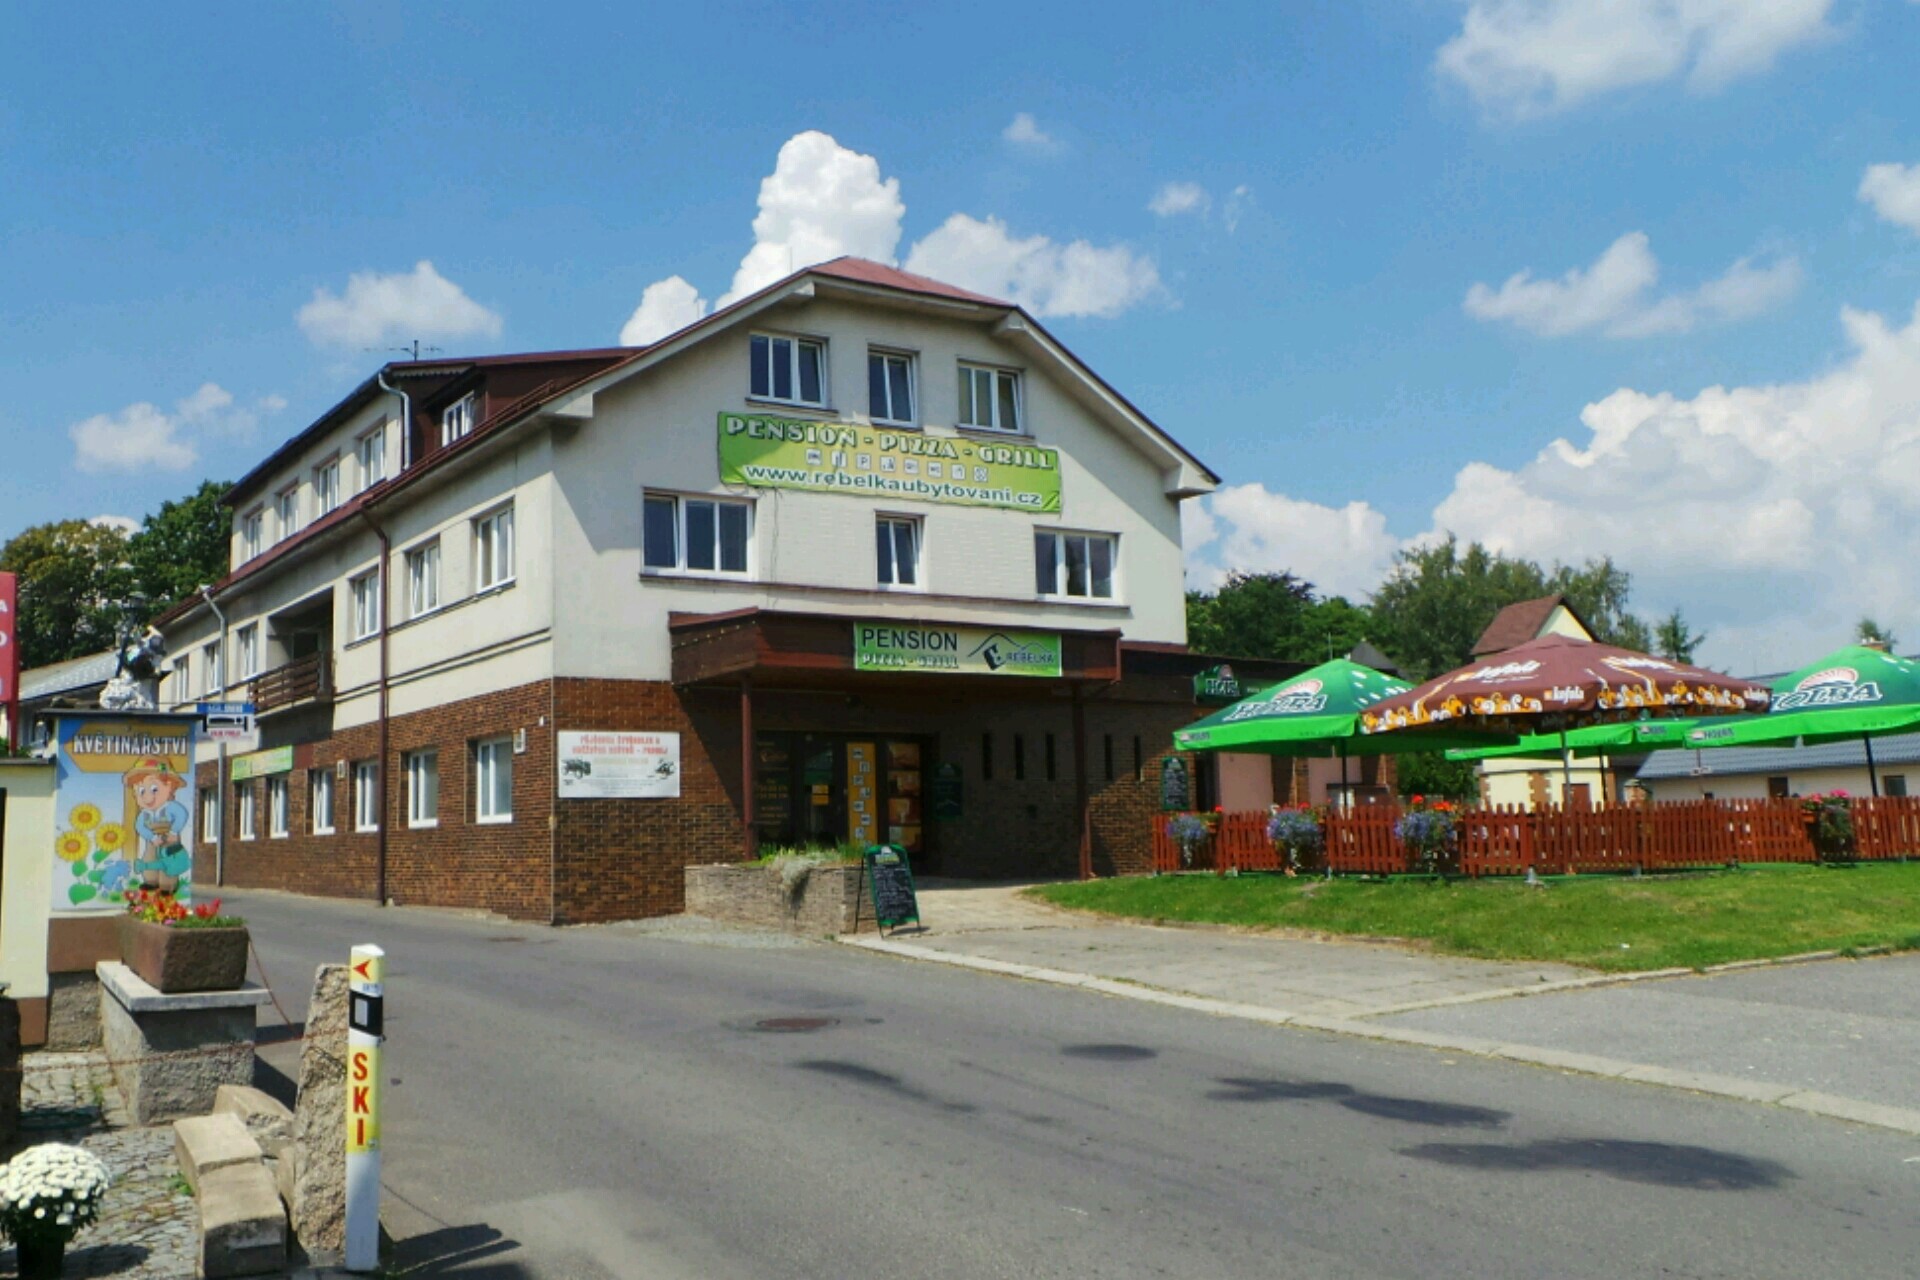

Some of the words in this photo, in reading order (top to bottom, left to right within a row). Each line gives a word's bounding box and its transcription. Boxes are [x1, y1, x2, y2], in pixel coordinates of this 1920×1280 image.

[726, 416, 857, 447] PENSION
[880, 433, 959, 460] PIZZA
[979, 446, 1055, 471] GRILL
[746, 465, 1042, 506] www.rebelkaubytovani.cz
[861, 652, 906, 668] PIZZA
[862, 628, 958, 651] PENSION
[353, 1052, 370, 1146] SKI
